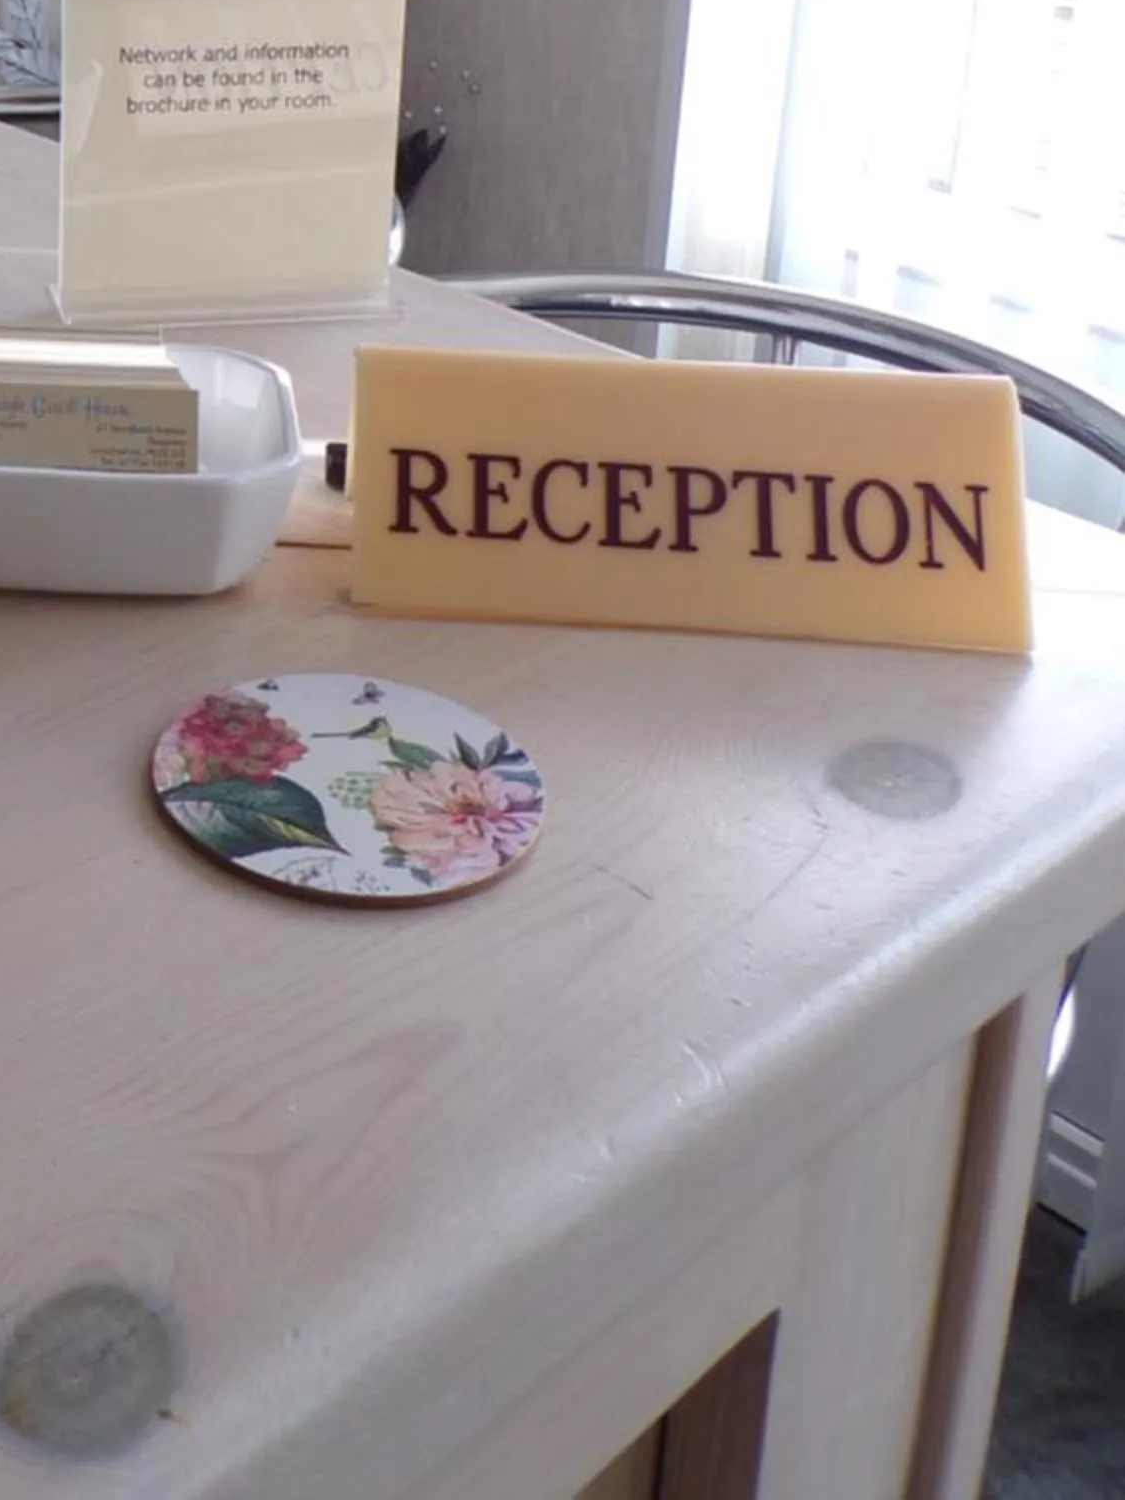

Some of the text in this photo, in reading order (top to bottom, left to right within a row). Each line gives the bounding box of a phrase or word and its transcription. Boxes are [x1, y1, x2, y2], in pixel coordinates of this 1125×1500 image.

[119, 42, 350, 65] Network and information
[143, 67, 324, 90] can be found in the
[126, 96, 209, 115] brochure
[215, 96, 231, 111] in
[238, 96, 279, 114] your
[387, 447, 989, 573] RECEPTION
